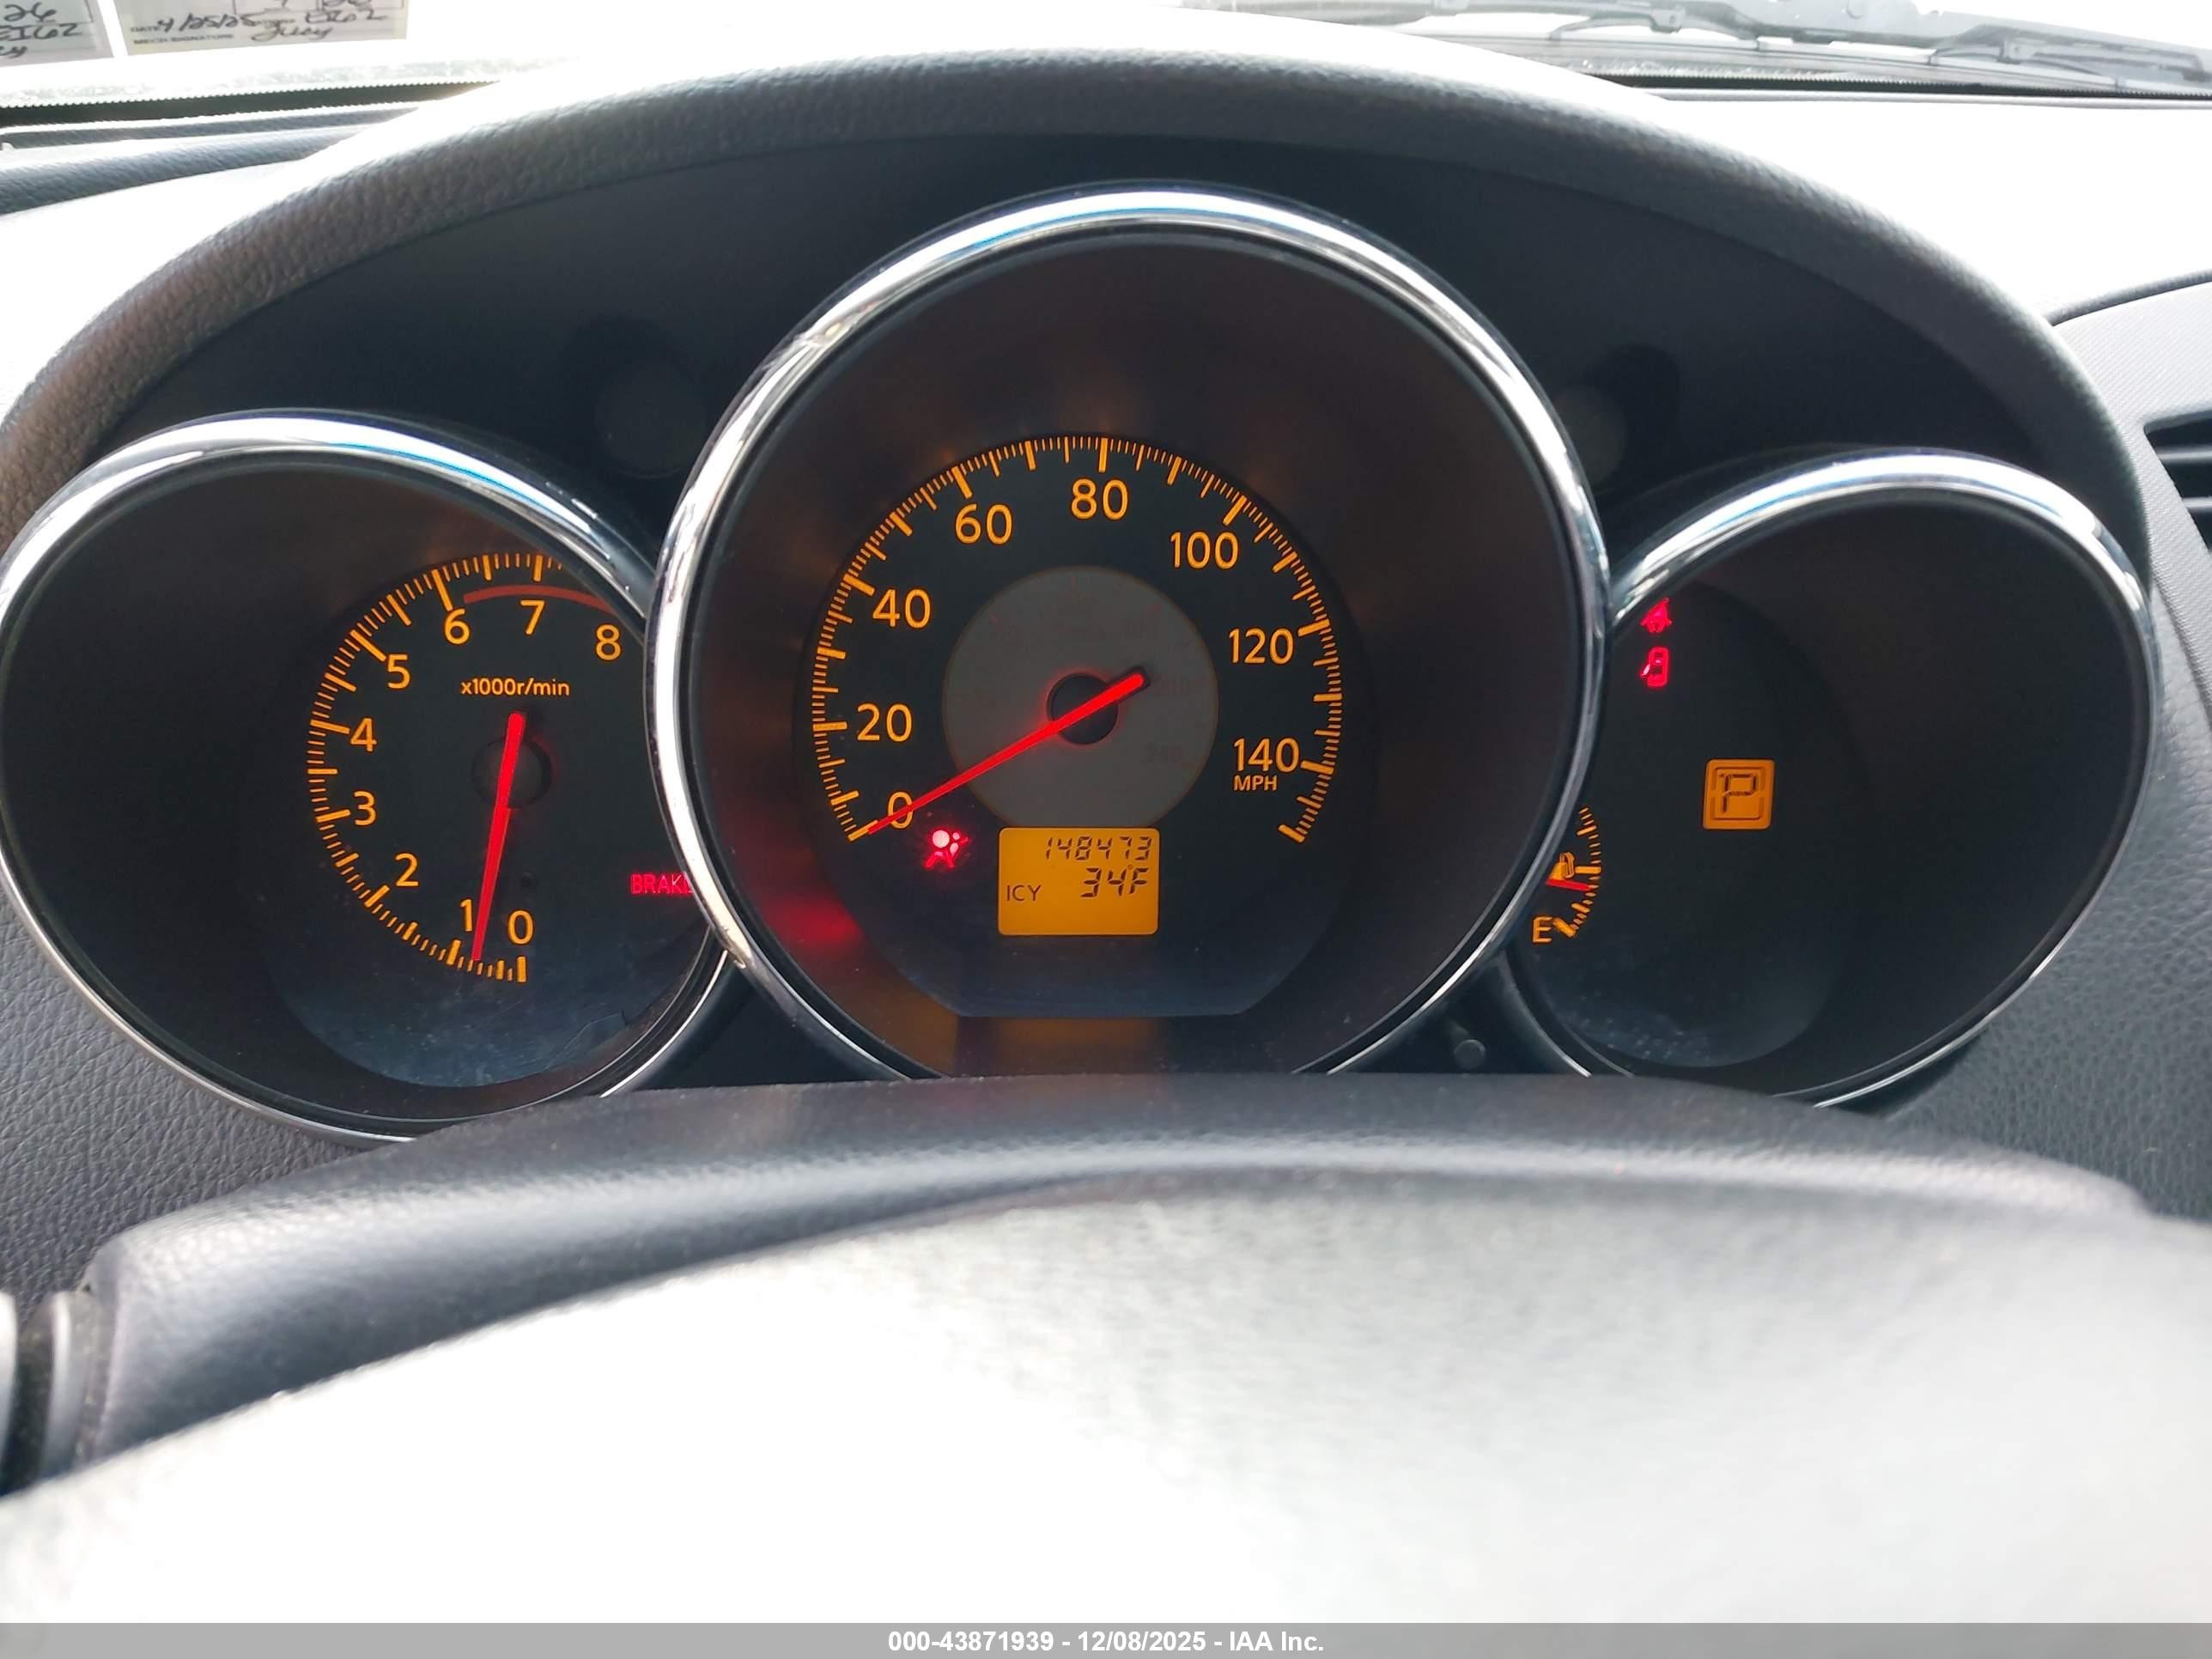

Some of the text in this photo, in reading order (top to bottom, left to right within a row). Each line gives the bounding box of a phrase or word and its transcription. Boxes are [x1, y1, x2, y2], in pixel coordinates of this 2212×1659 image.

[1071, 478, 1128, 520] 80
[955, 503, 1012, 545] 60
[1170, 531, 1239, 569] 100
[444, 606, 471, 645] 6
[520, 600, 545, 635] 7
[872, 589, 932, 629] 40
[595, 623, 622, 661] 8
[1229, 628, 1294, 665] 120
[386, 653, 411, 690] 5
[461, 677, 570, 696] x1000r/min
[349, 717, 377, 752] 4
[856, 702, 913, 742] 20
[1233, 738, 1300, 773] 140
[1233, 775, 1278, 791] MPH
[1720, 773, 1758, 813] P
[353, 790, 377, 826] 3
[887, 791, 915, 830] 0
[1046, 836, 1152, 860] 148473
[394, 853, 419, 887] 2
[1006, 884, 1042, 902] ICY
[459, 898, 473, 933] 1
[507, 909, 534, 945] 0
[1532, 916, 1552, 943] E
